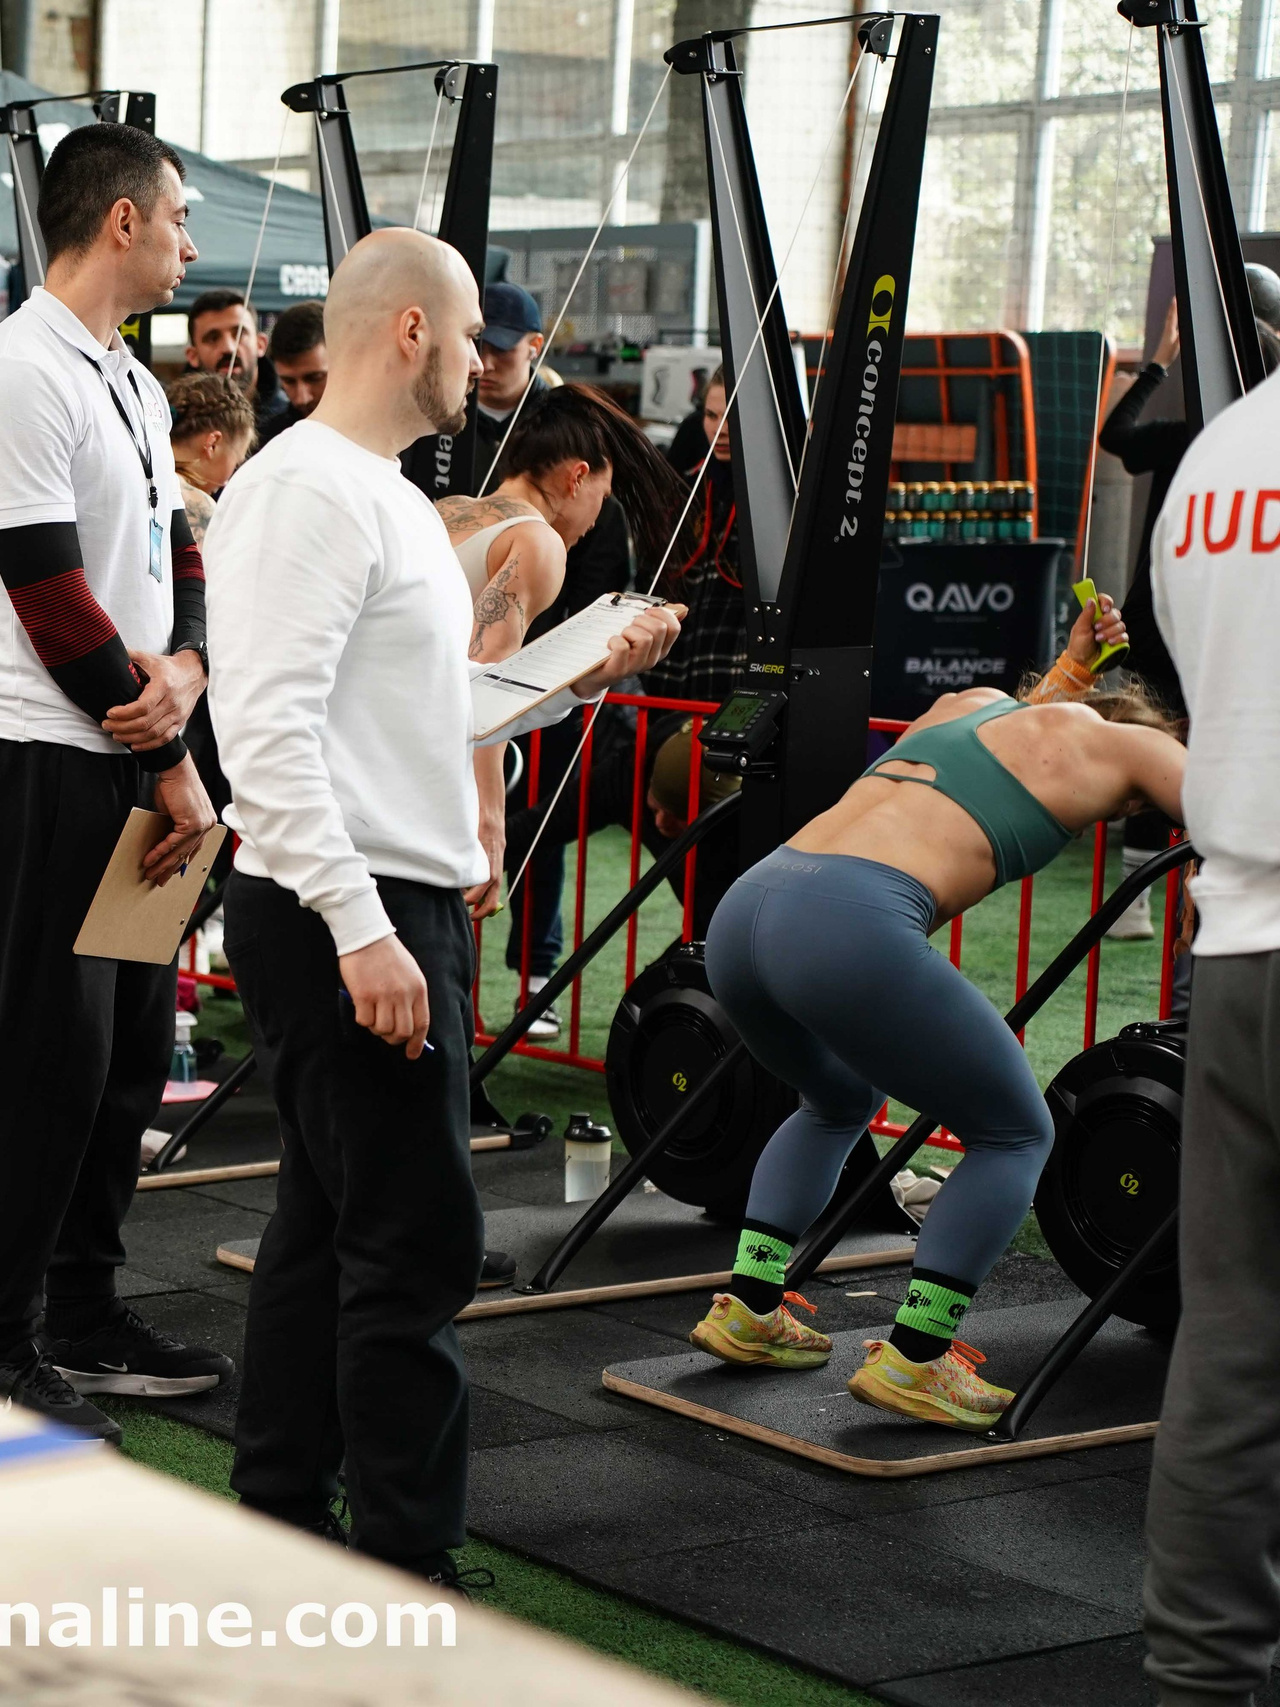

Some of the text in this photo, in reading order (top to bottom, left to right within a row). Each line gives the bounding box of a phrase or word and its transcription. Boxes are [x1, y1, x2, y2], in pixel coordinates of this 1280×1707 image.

[839, 339, 883, 538] concept 2
[434, 434, 453, 489] ept
[906, 582, 1014, 612] QAVO
[749, 663, 785, 675] SkiERG
[905, 657, 1007, 674] BALANCE
[925, 674, 974, 686] YOUR
[672, 1072, 687, 1092] C2
[1120, 1173, 1139, 1195] C2
